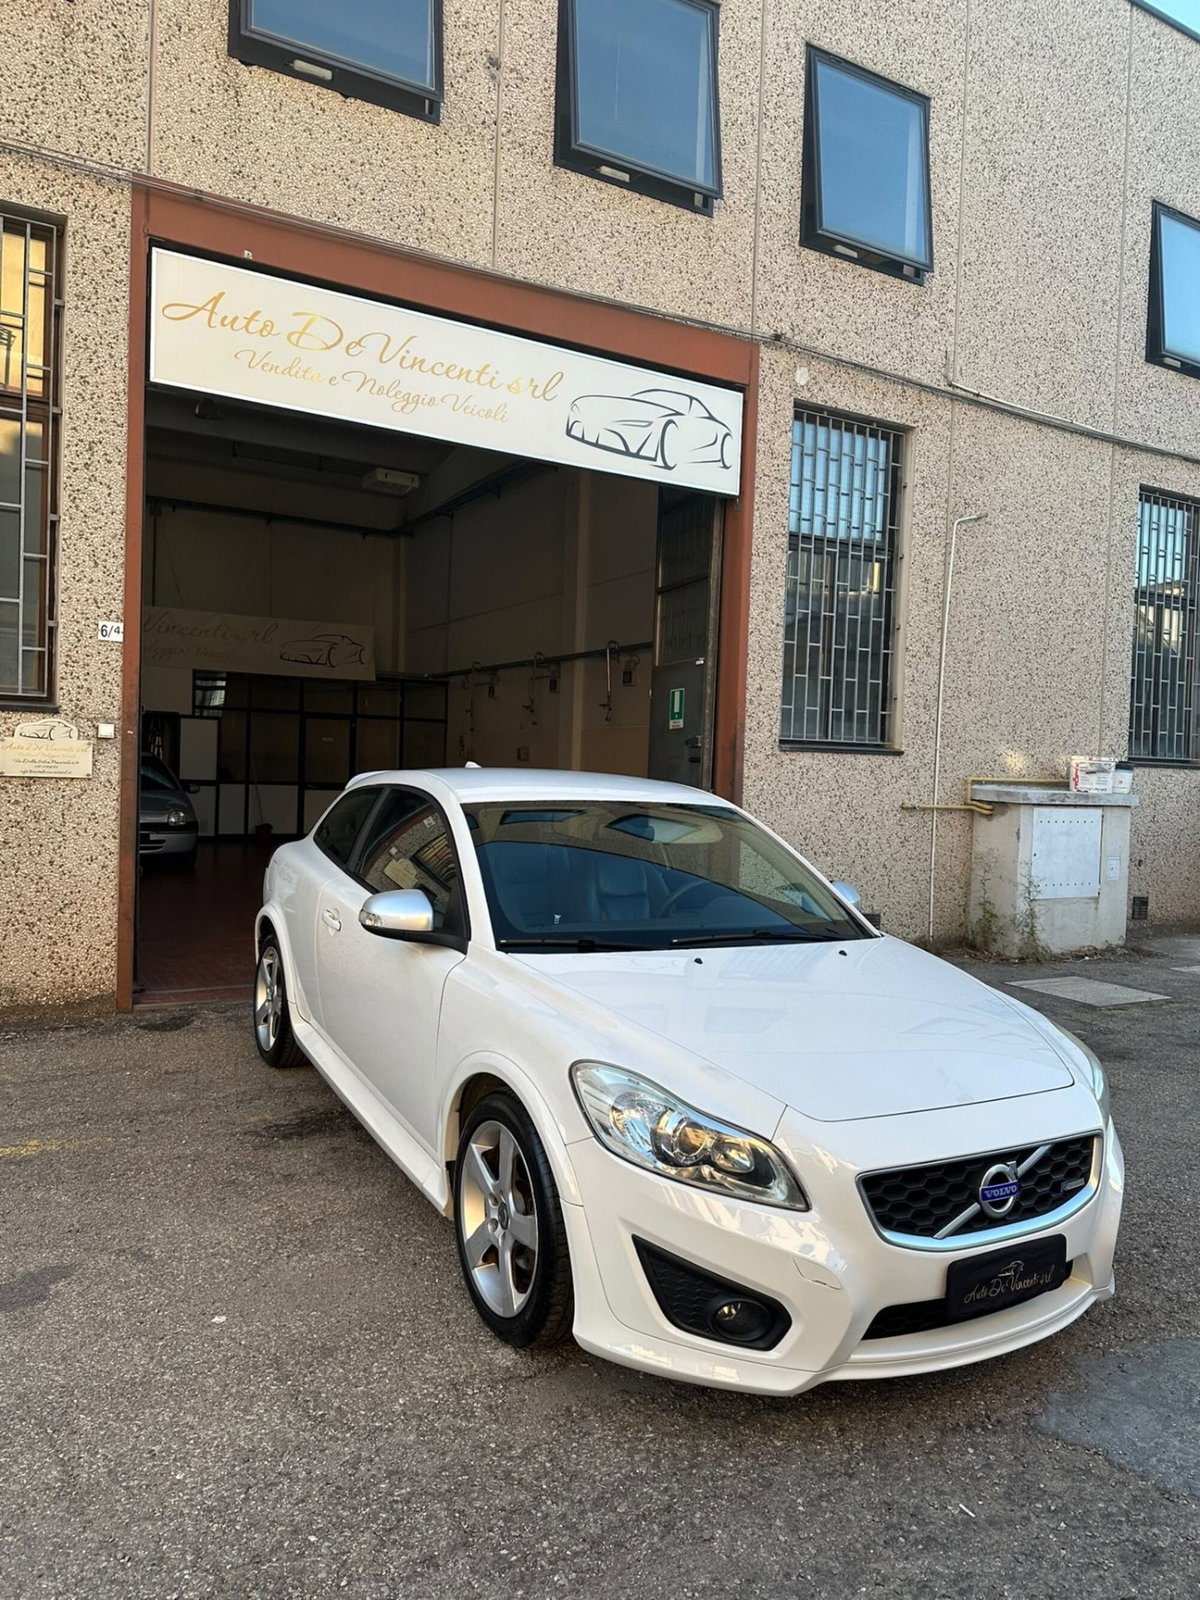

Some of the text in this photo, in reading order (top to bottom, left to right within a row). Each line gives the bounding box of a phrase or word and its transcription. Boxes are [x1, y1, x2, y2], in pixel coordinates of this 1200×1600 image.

[162, 291, 564, 402] Auto De Vincenti srl
[234, 349, 510, 423] Vendita e Noleggio Veicoli
[100, 624, 120, 638] 6/4
[984, 1185, 1017, 1198] VOLVO
